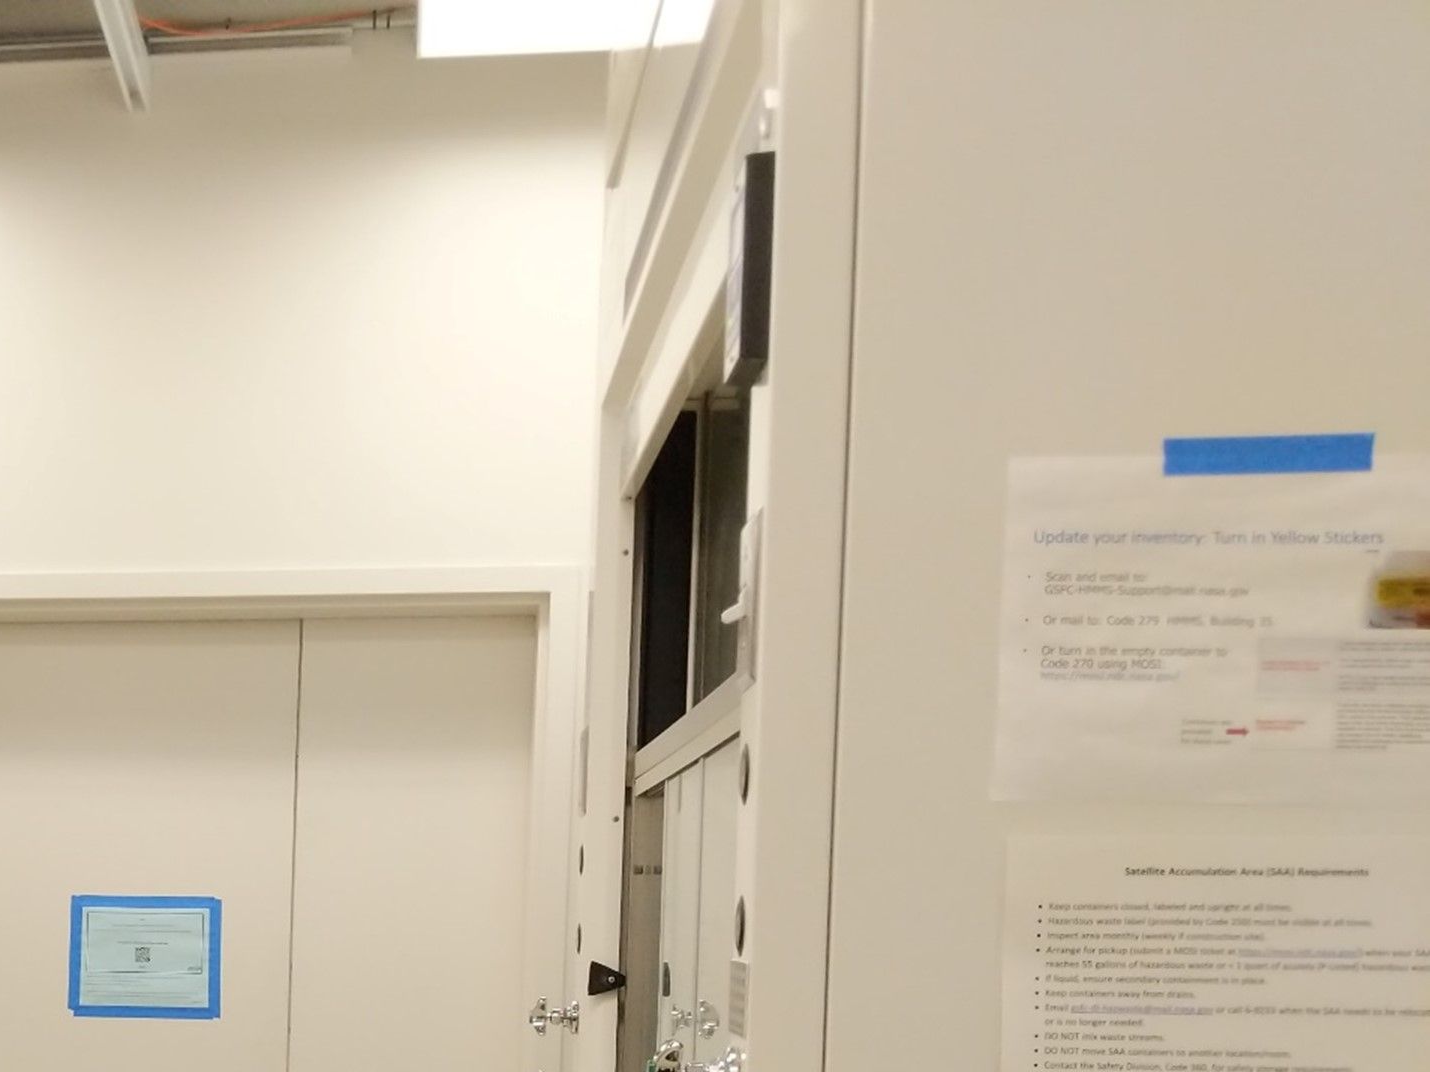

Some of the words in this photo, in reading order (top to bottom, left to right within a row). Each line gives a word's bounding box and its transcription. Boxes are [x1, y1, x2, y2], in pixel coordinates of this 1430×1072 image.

[1034, 531, 1089, 546] Update
[1093, 534, 1127, 546] your
[1214, 531, 1247, 544] Turn
[1252, 531, 1265, 544] in
[1270, 531, 1320, 544] Yellow
[1325, 531, 1384, 544] Stickers
[1076, 572, 1096, 582] and
[1043, 615, 1057, 626] Or
[1106, 615, 1134, 626] Code
[1041, 646, 1054, 656] Or
[1059, 646, 1081, 656] turn
[1099, 646, 1118, 656] the
[1041, 659, 1070, 669] Code
[1097, 660, 1127, 671] using
[1125, 867, 1165, 877] Satellite
[1169, 867, 1236, 877] Accumulation
[1240, 867, 1263, 877] Area
[1297, 868, 1369, 878] Requirements
[1046, 947, 1081, 955] Arrange
[1084, 947, 1095, 956] for
[1098, 947, 1128, 956] pickup
[1044, 1061, 1077, 1071] Contact
[1097, 1061, 1123, 1071] Safety
